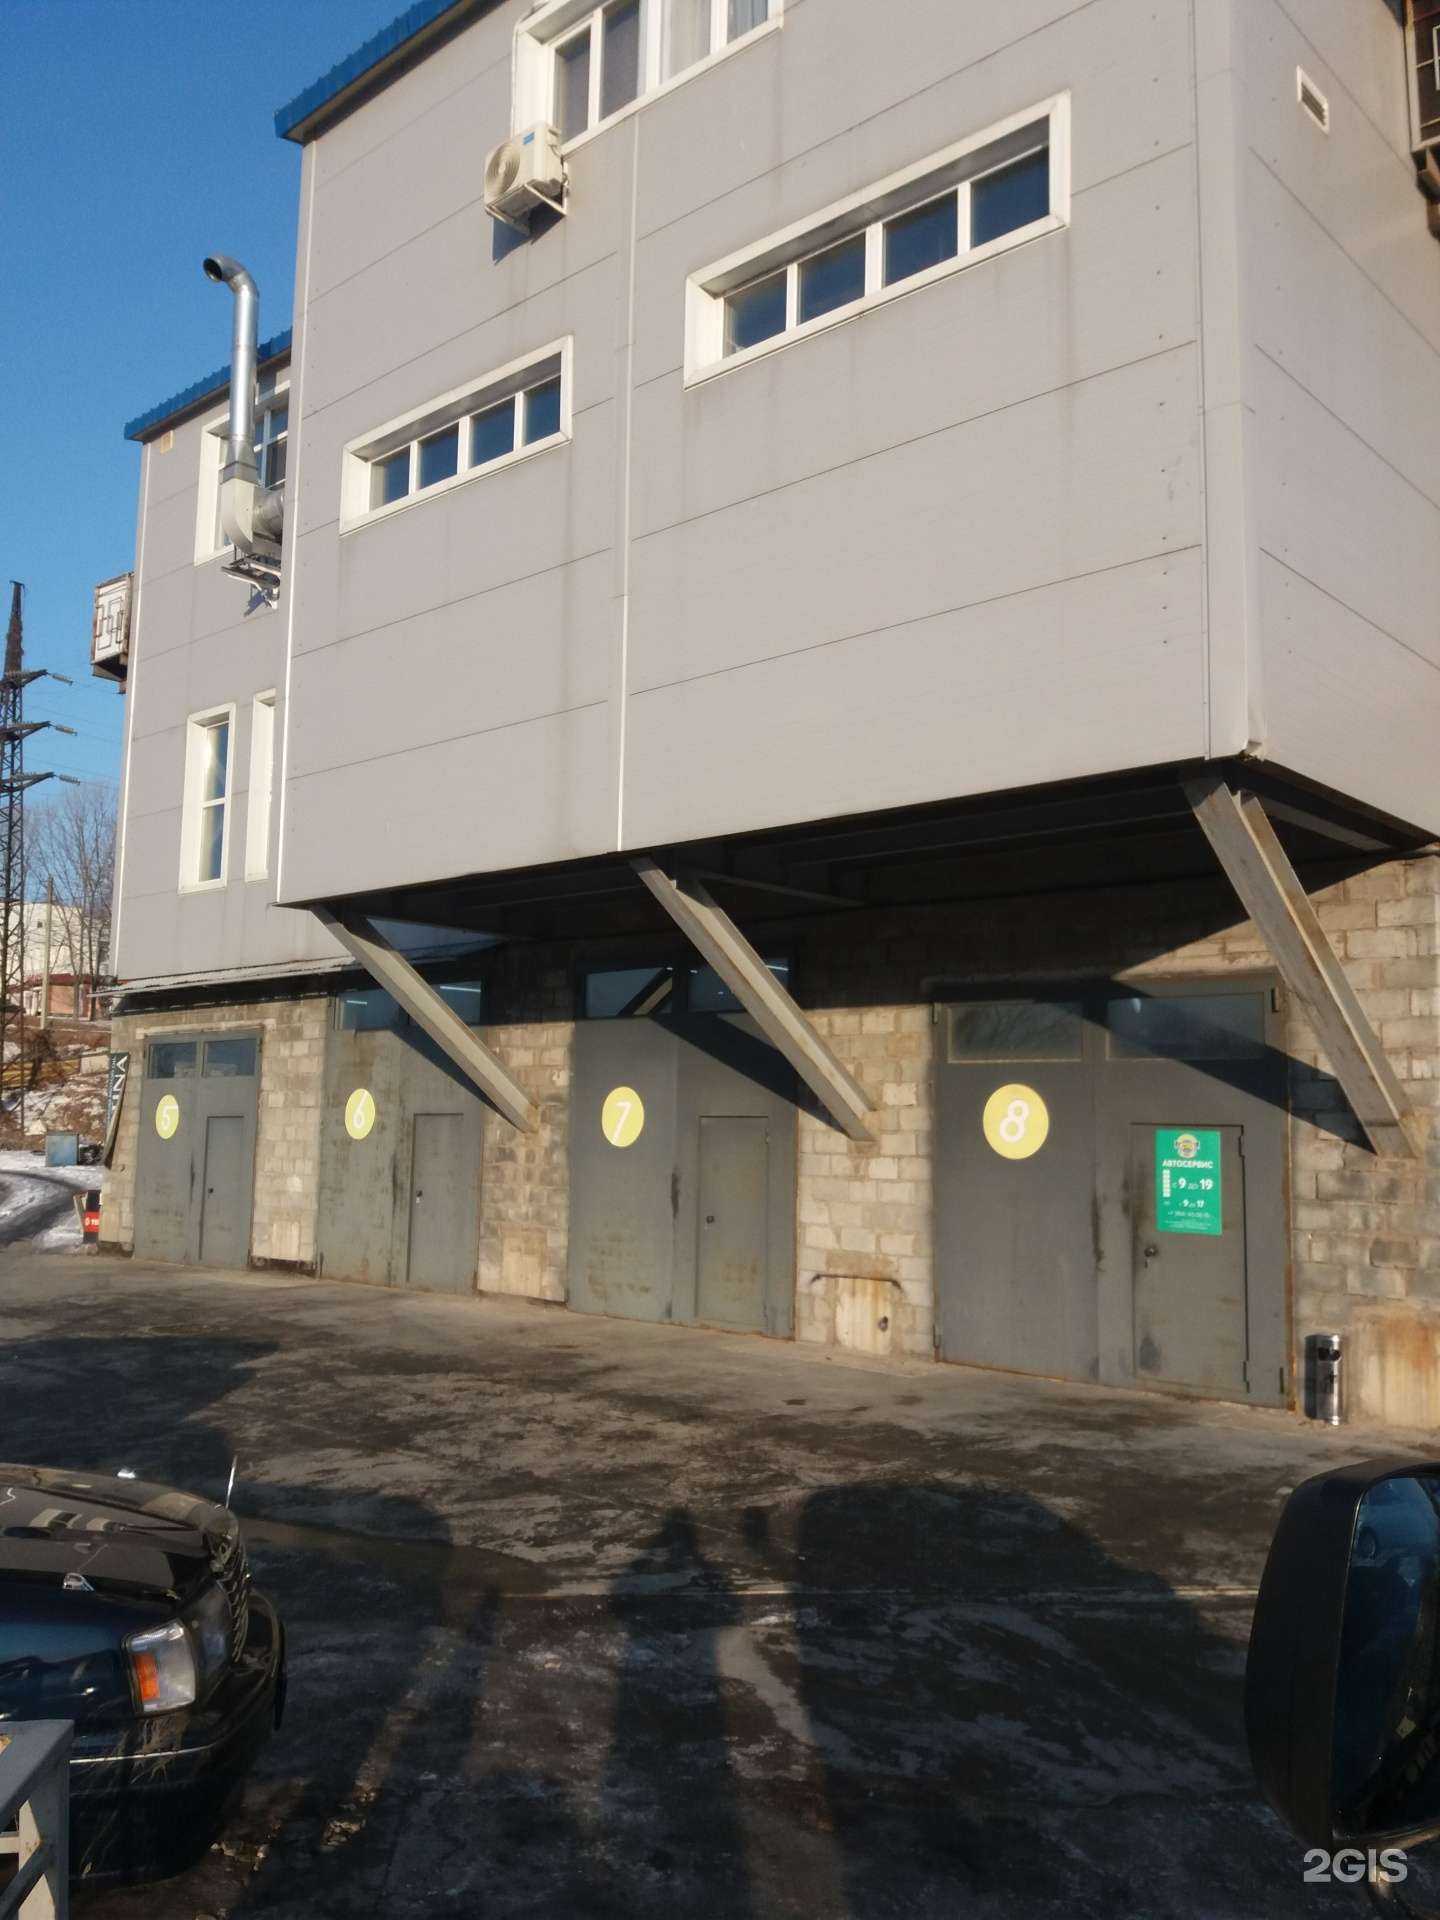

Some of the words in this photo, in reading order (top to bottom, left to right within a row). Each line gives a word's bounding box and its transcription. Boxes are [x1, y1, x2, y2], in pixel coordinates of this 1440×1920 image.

[161, 1104, 178, 1130] 5
[352, 1090, 368, 1129] 6
[611, 1101, 632, 1142] 7
[1000, 1099, 1029, 1143] 8
[1162, 1159, 1214, 1169] АВТОСЕРВИС
[1178, 1178, 1186, 1189] 9
[1200, 1178, 1213, 1190] 19
